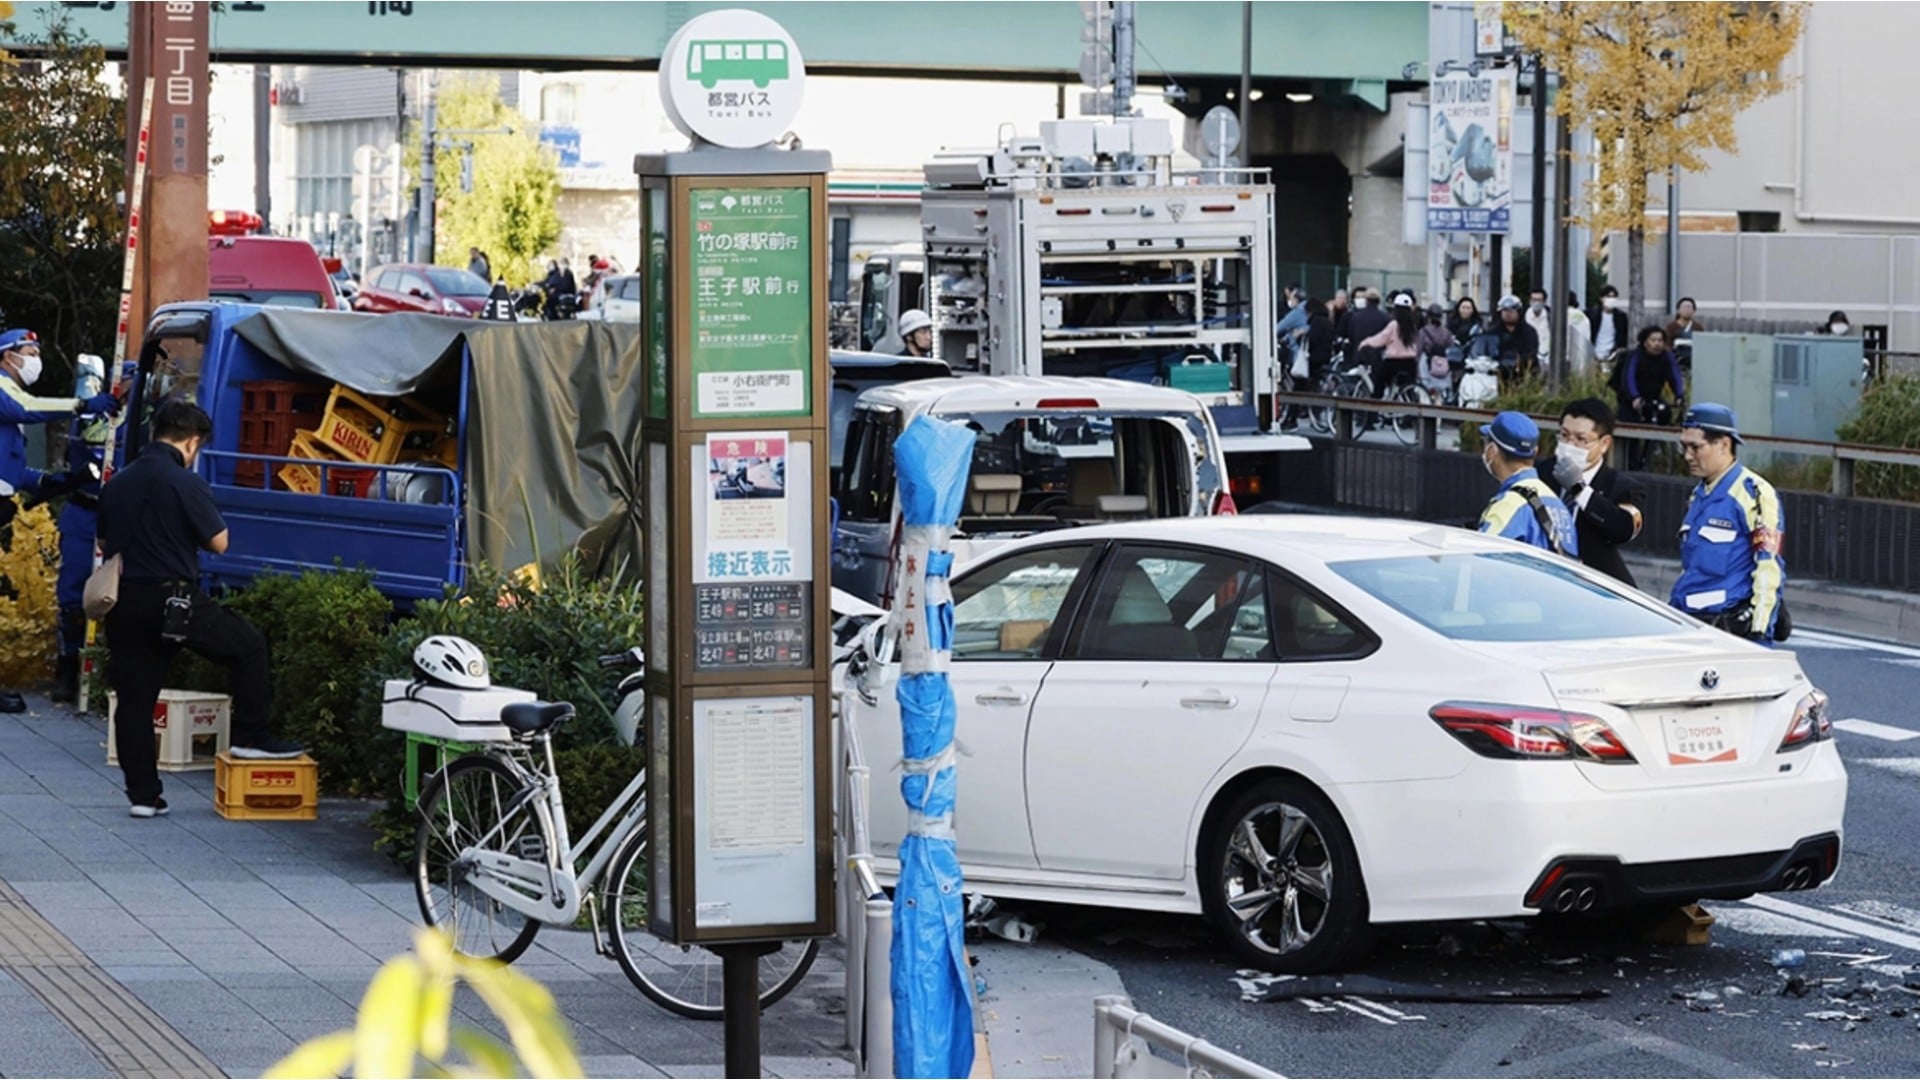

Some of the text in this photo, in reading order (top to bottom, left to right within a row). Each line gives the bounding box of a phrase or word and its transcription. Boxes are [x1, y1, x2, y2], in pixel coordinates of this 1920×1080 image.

[708, 92, 770, 107] 都営バス
[741, 195, 784, 206] 都営バス
[698, 232, 798, 251] 竹の塚駅前行
[698, 276, 799, 296] 王子駅前行
[733, 375, 790, 388] 小右衛門町
[332, 422, 374, 460] KIRIN
[727, 440, 769, 456] 危険
[708, 550, 792, 577] 接近表示
[1688, 727, 1722, 738] TOYOTA
